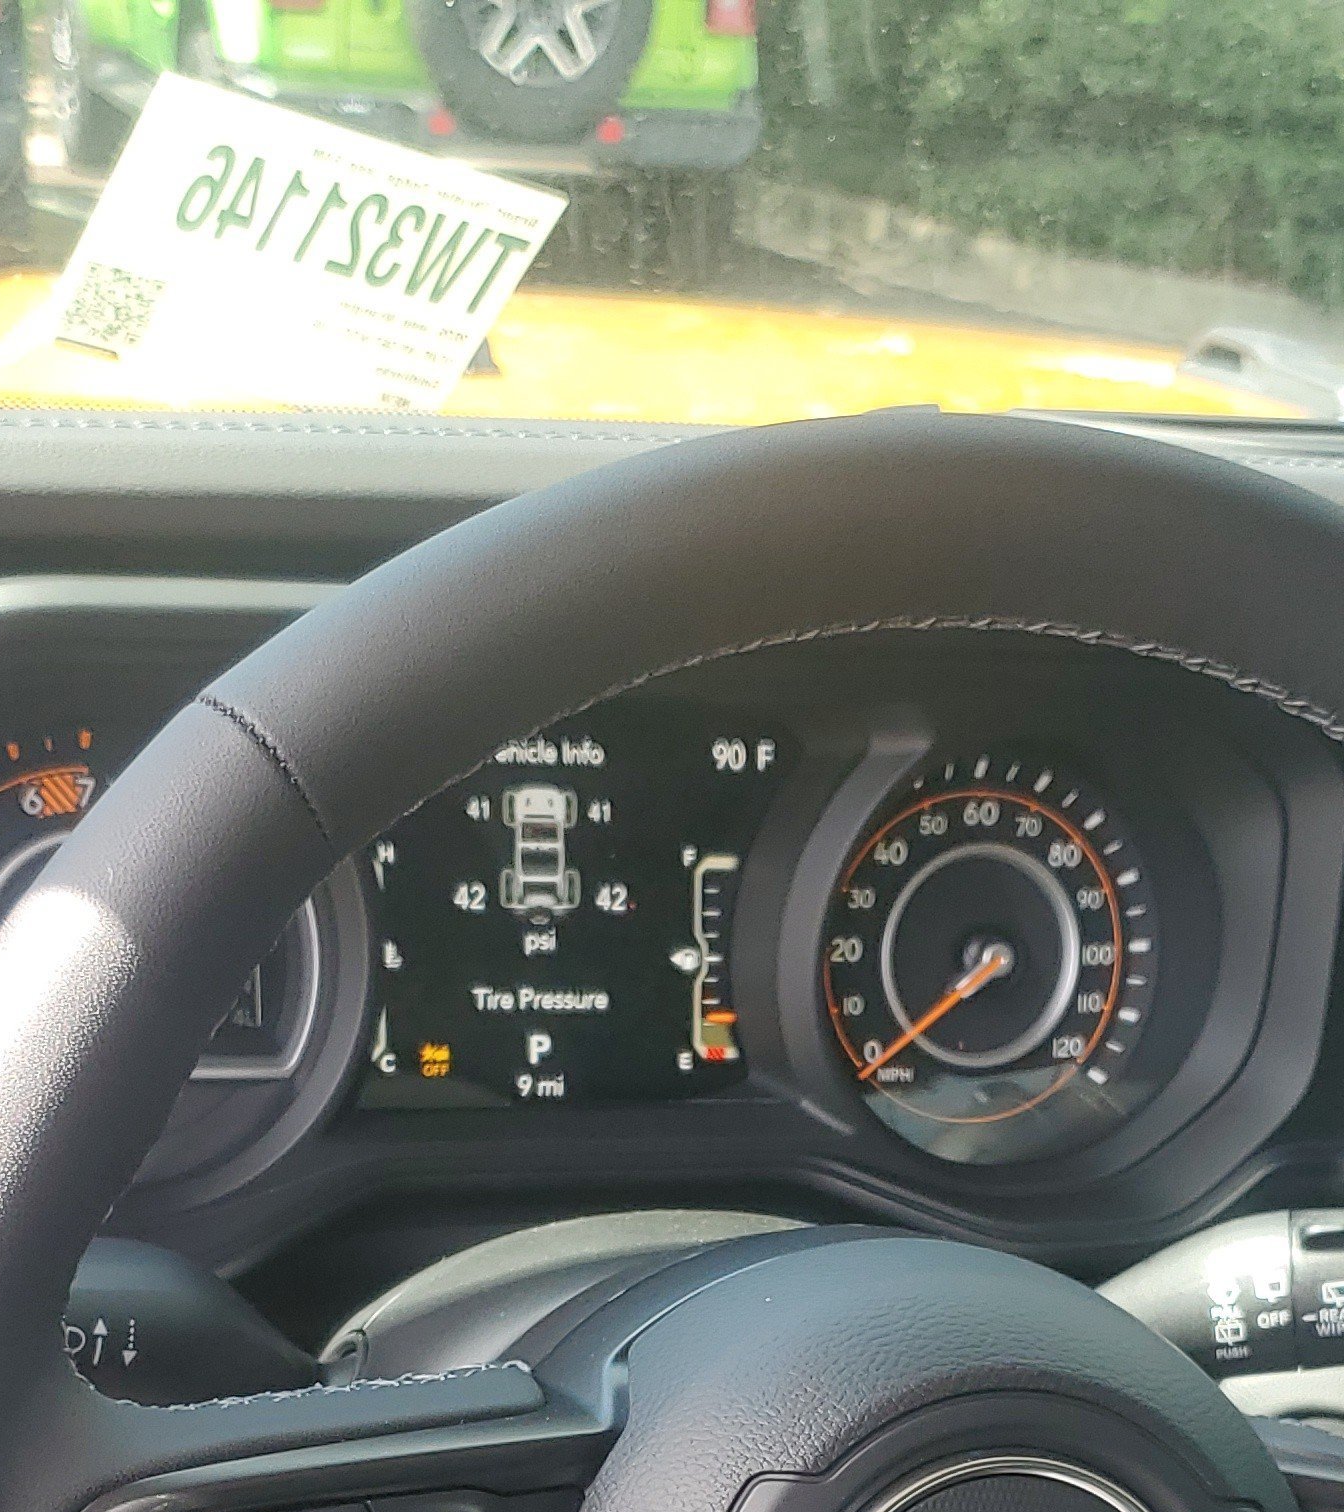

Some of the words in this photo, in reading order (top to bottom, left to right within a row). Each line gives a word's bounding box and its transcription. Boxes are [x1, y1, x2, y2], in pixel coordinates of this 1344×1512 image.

[561, 736, 605, 767] Info
[713, 739, 746, 772] 90
[757, 739, 776, 772] F
[21, 786, 42, 815] 6
[465, 798, 491, 820] 41
[587, 799, 612, 823] 41
[919, 815, 949, 836] 50
[963, 802, 1001, 827] 60
[1015, 815, 1043, 838] 70
[874, 841, 909, 867] 40
[1048, 843, 1083, 869] 80
[454, 882, 486, 911] 42
[595, 882, 628, 913] 42
[846, 889, 876, 909] 30
[523, 930, 557, 956] psi
[830, 939, 864, 963] 20
[1081, 944, 1115, 966] 100
[472, 988, 514, 1010] Tire
[519, 987, 609, 1010] Pressure
[843, 997, 865, 1017] 10
[1077, 995, 1103, 1015] 110
[529, 1034, 551, 1064] P
[1052, 1037, 1085, 1060] 120
[422, 1063, 450, 1077] OFF
[877, 1065, 915, 1083] MPH
[518, 1074, 532, 1096] 9
[536, 1073, 565, 1097] mi
[1257, 1309, 1291, 1329] OFF
[1215, 1346, 1249, 1360] PUSH
